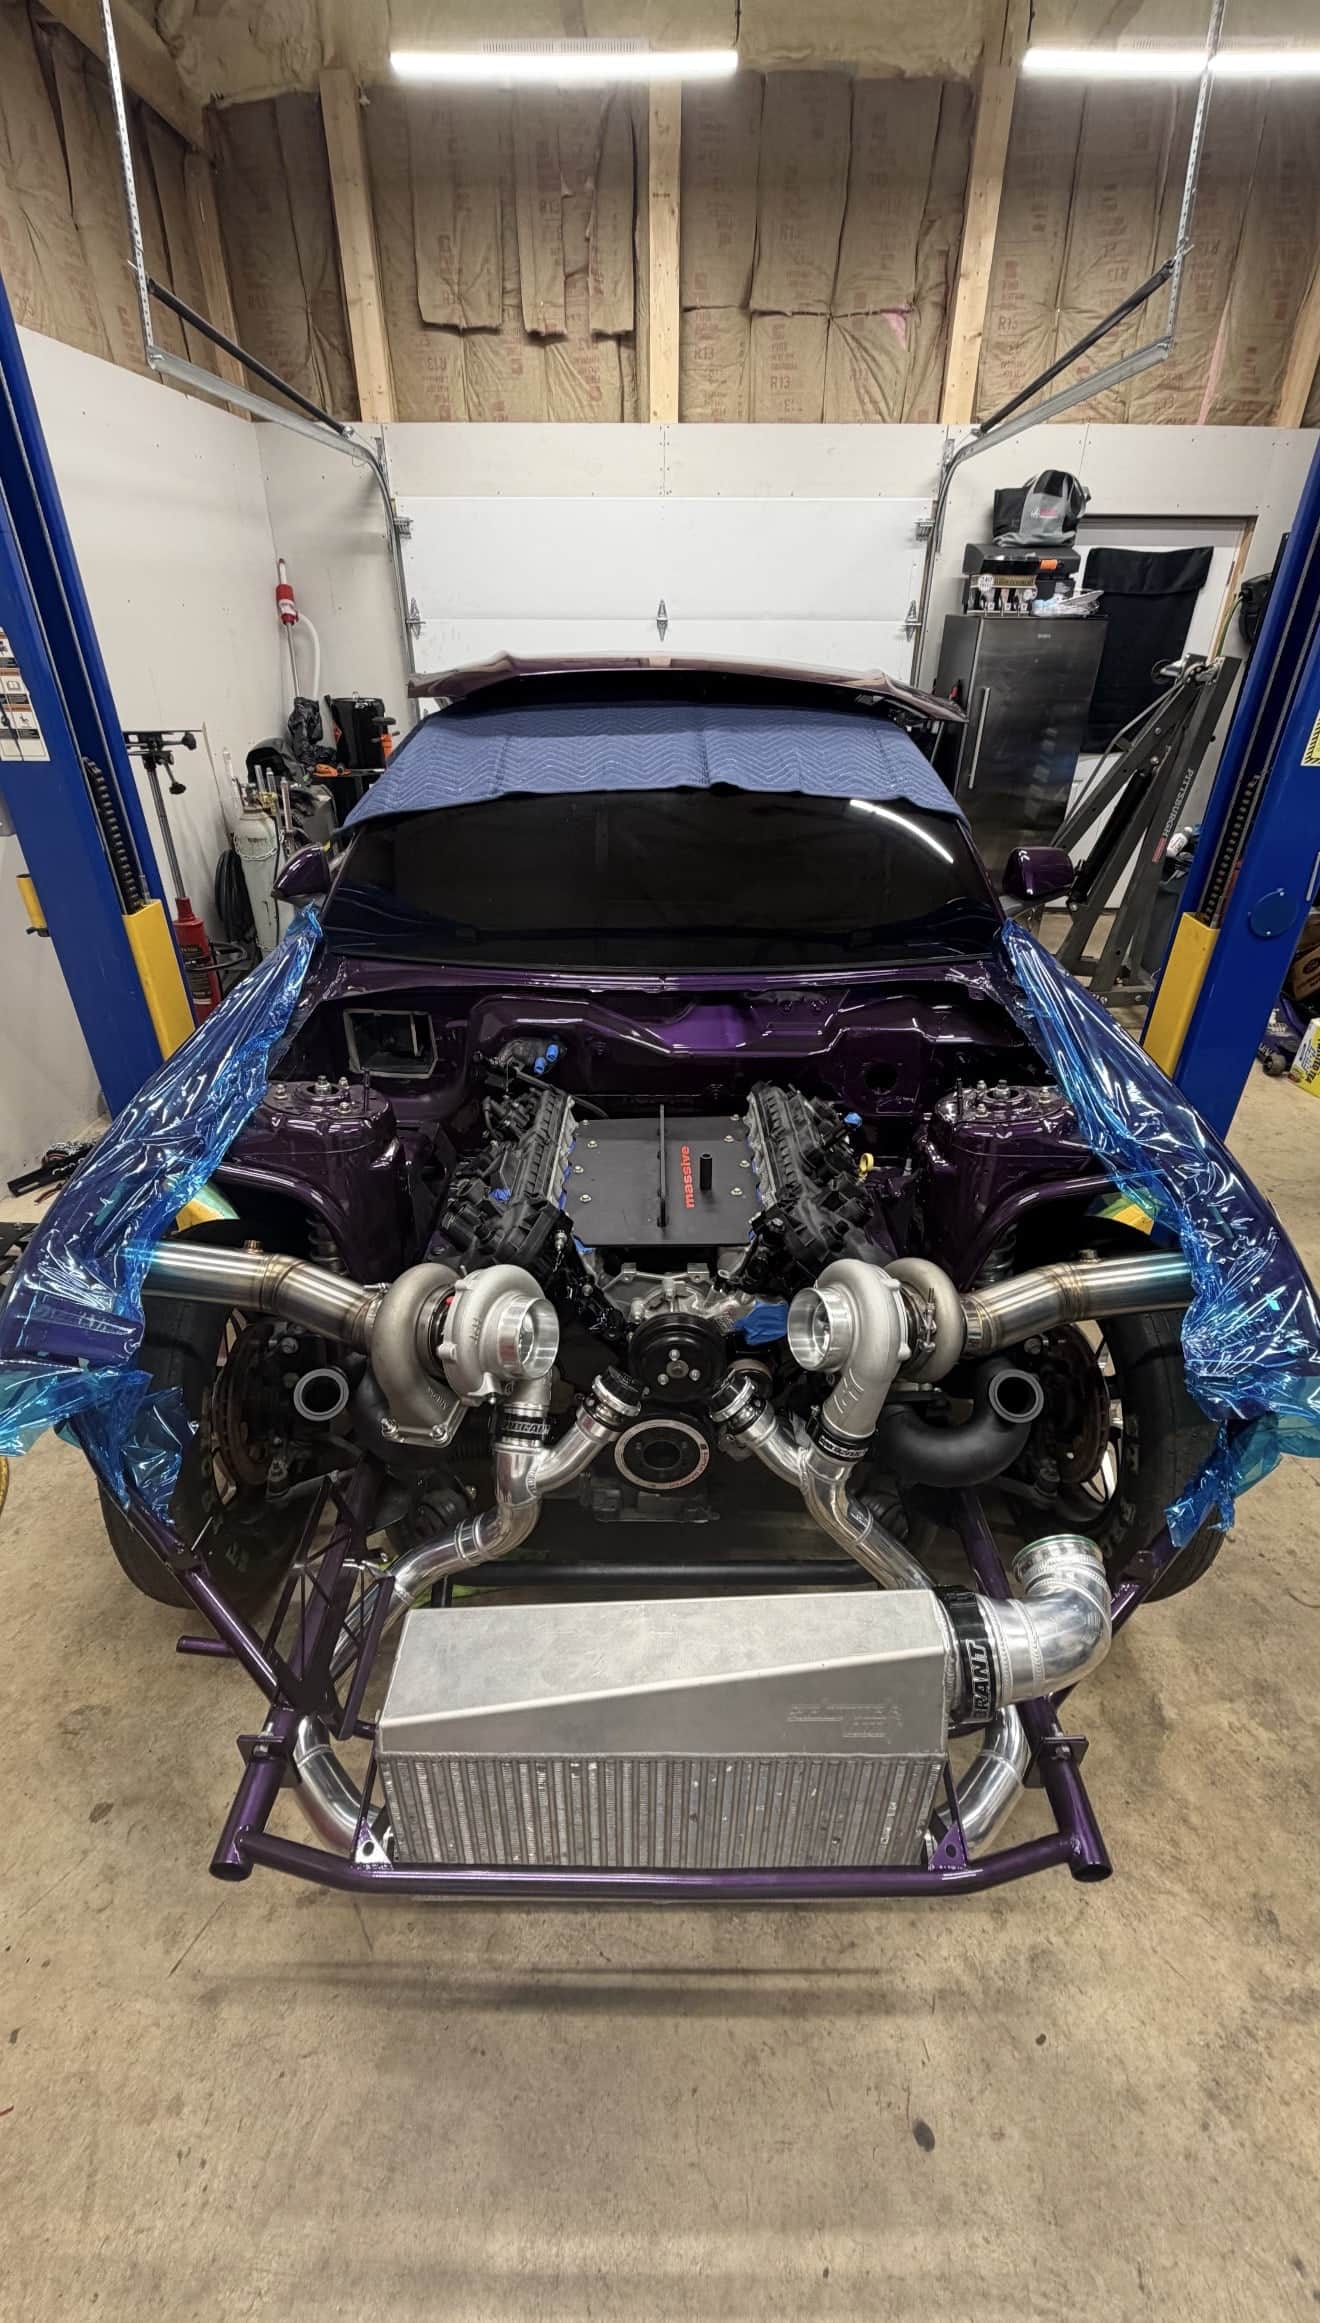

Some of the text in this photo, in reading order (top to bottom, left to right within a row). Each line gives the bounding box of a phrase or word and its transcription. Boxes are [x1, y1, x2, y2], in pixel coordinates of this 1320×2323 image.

[770, 376, 791, 390] R13
[1162, 768, 1194, 837] PITTSBURGH
[680, 1145, 695, 1209] massive
